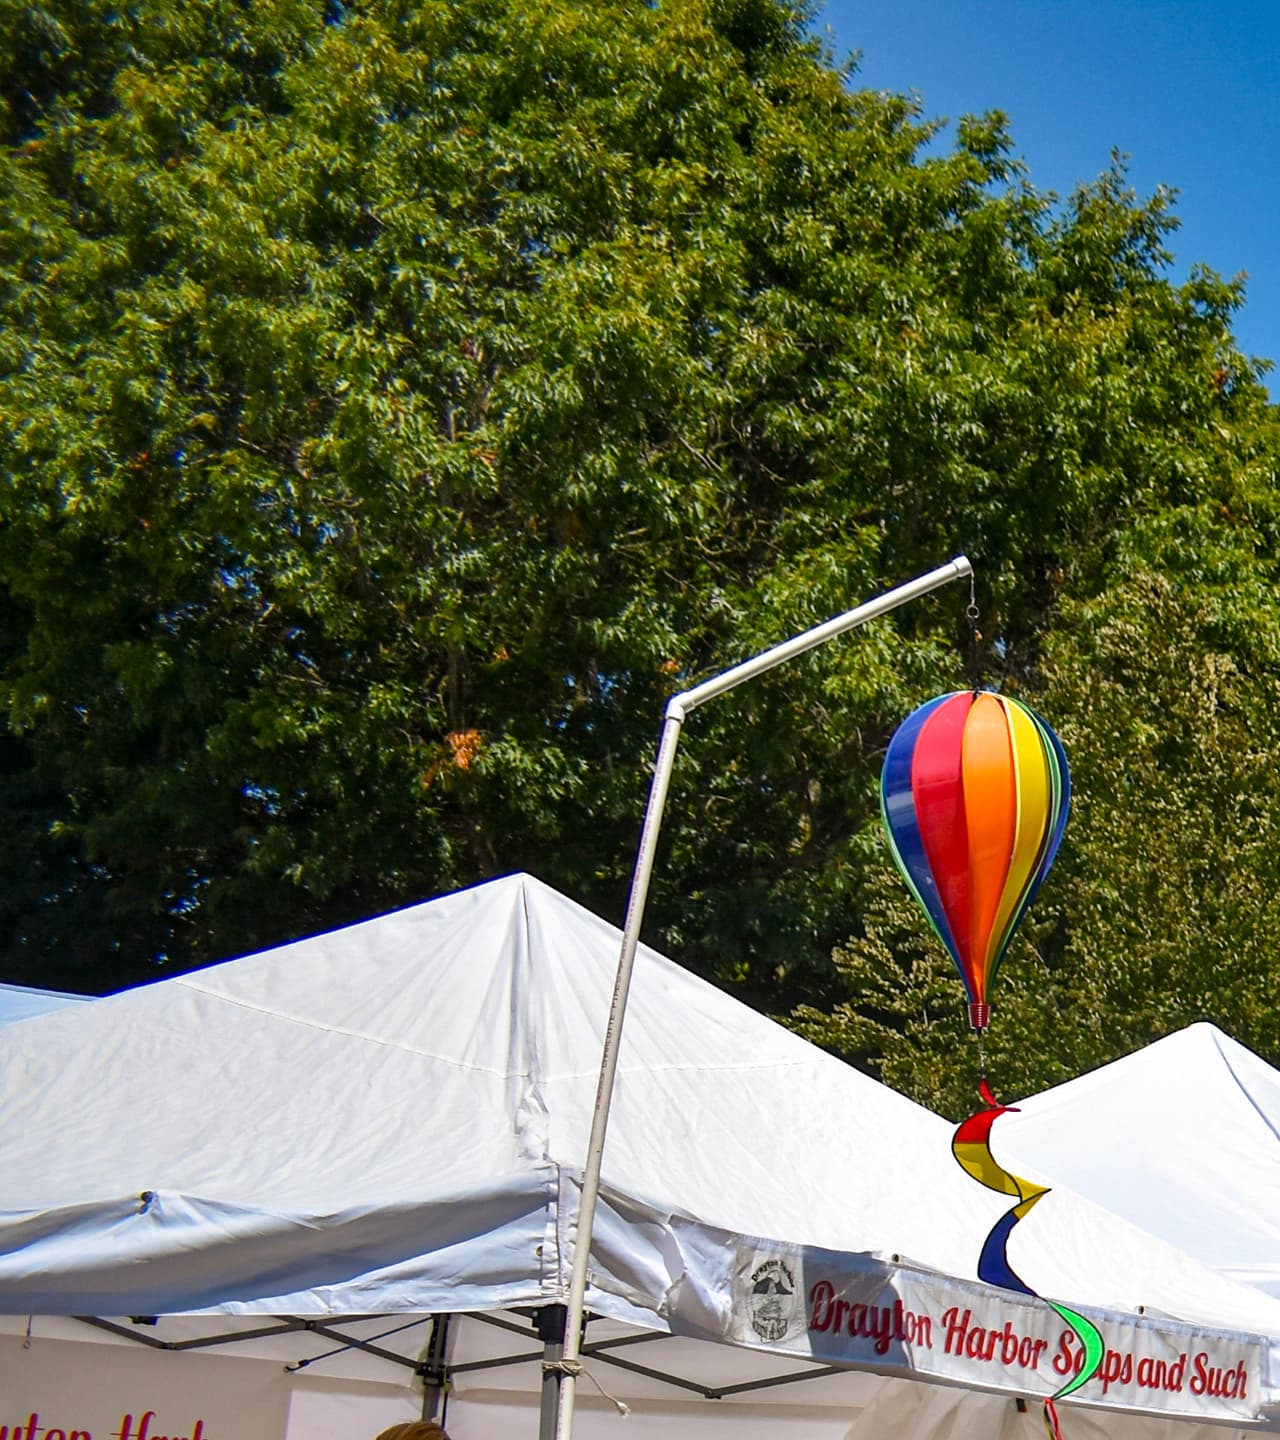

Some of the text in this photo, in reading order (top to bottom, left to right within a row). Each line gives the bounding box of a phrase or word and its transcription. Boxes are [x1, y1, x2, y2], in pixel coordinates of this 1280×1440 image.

[808, 1280, 932, 1354] Drayton
[942, 1307, 1048, 1370] Harbor
[1053, 1330, 1132, 1394] Sops
[1137, 1353, 1187, 1392] and
[1189, 1352, 1248, 1400] Such
